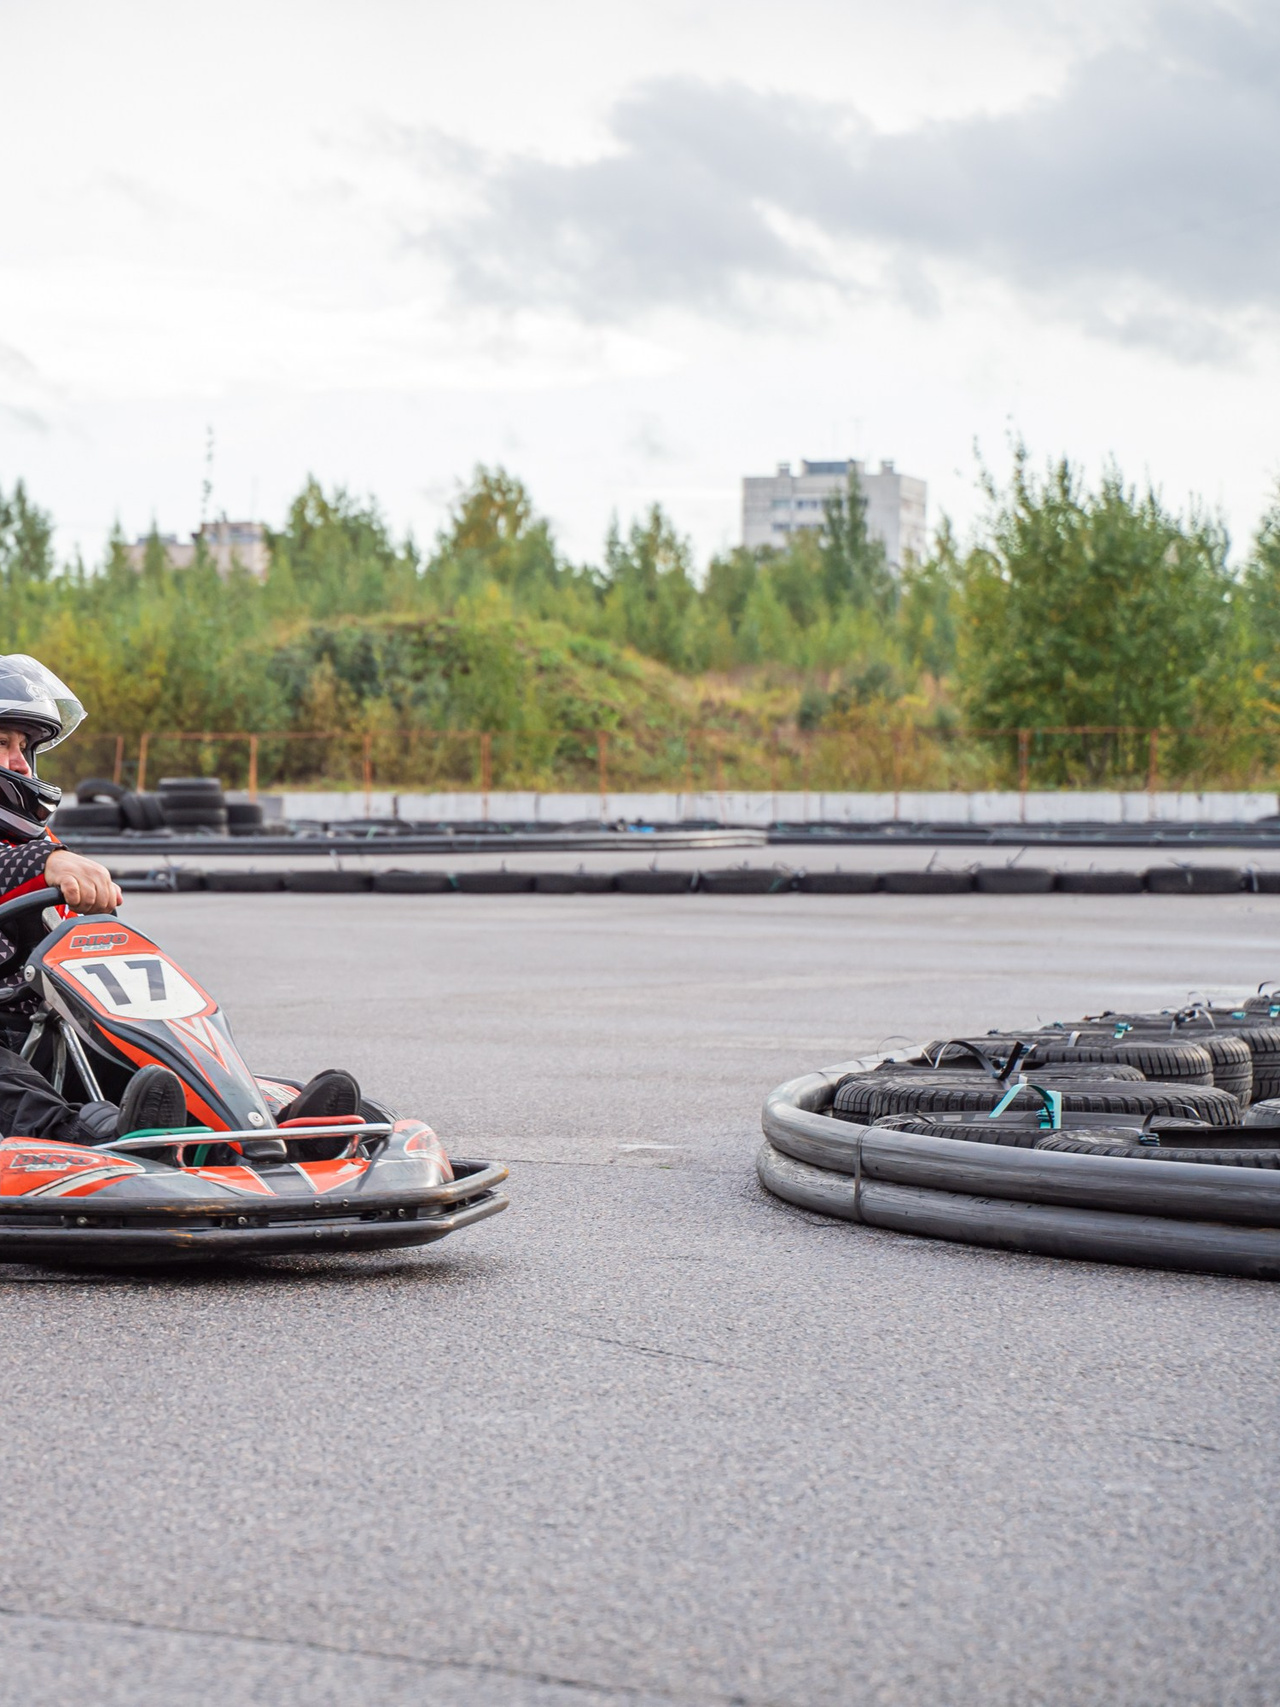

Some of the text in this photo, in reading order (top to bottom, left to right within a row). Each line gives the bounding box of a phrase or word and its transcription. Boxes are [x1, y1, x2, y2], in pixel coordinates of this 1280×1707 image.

[71, 934, 127, 947] DINO
[82, 959, 167, 1006] 17
[12, 1154, 95, 1167] DINO
